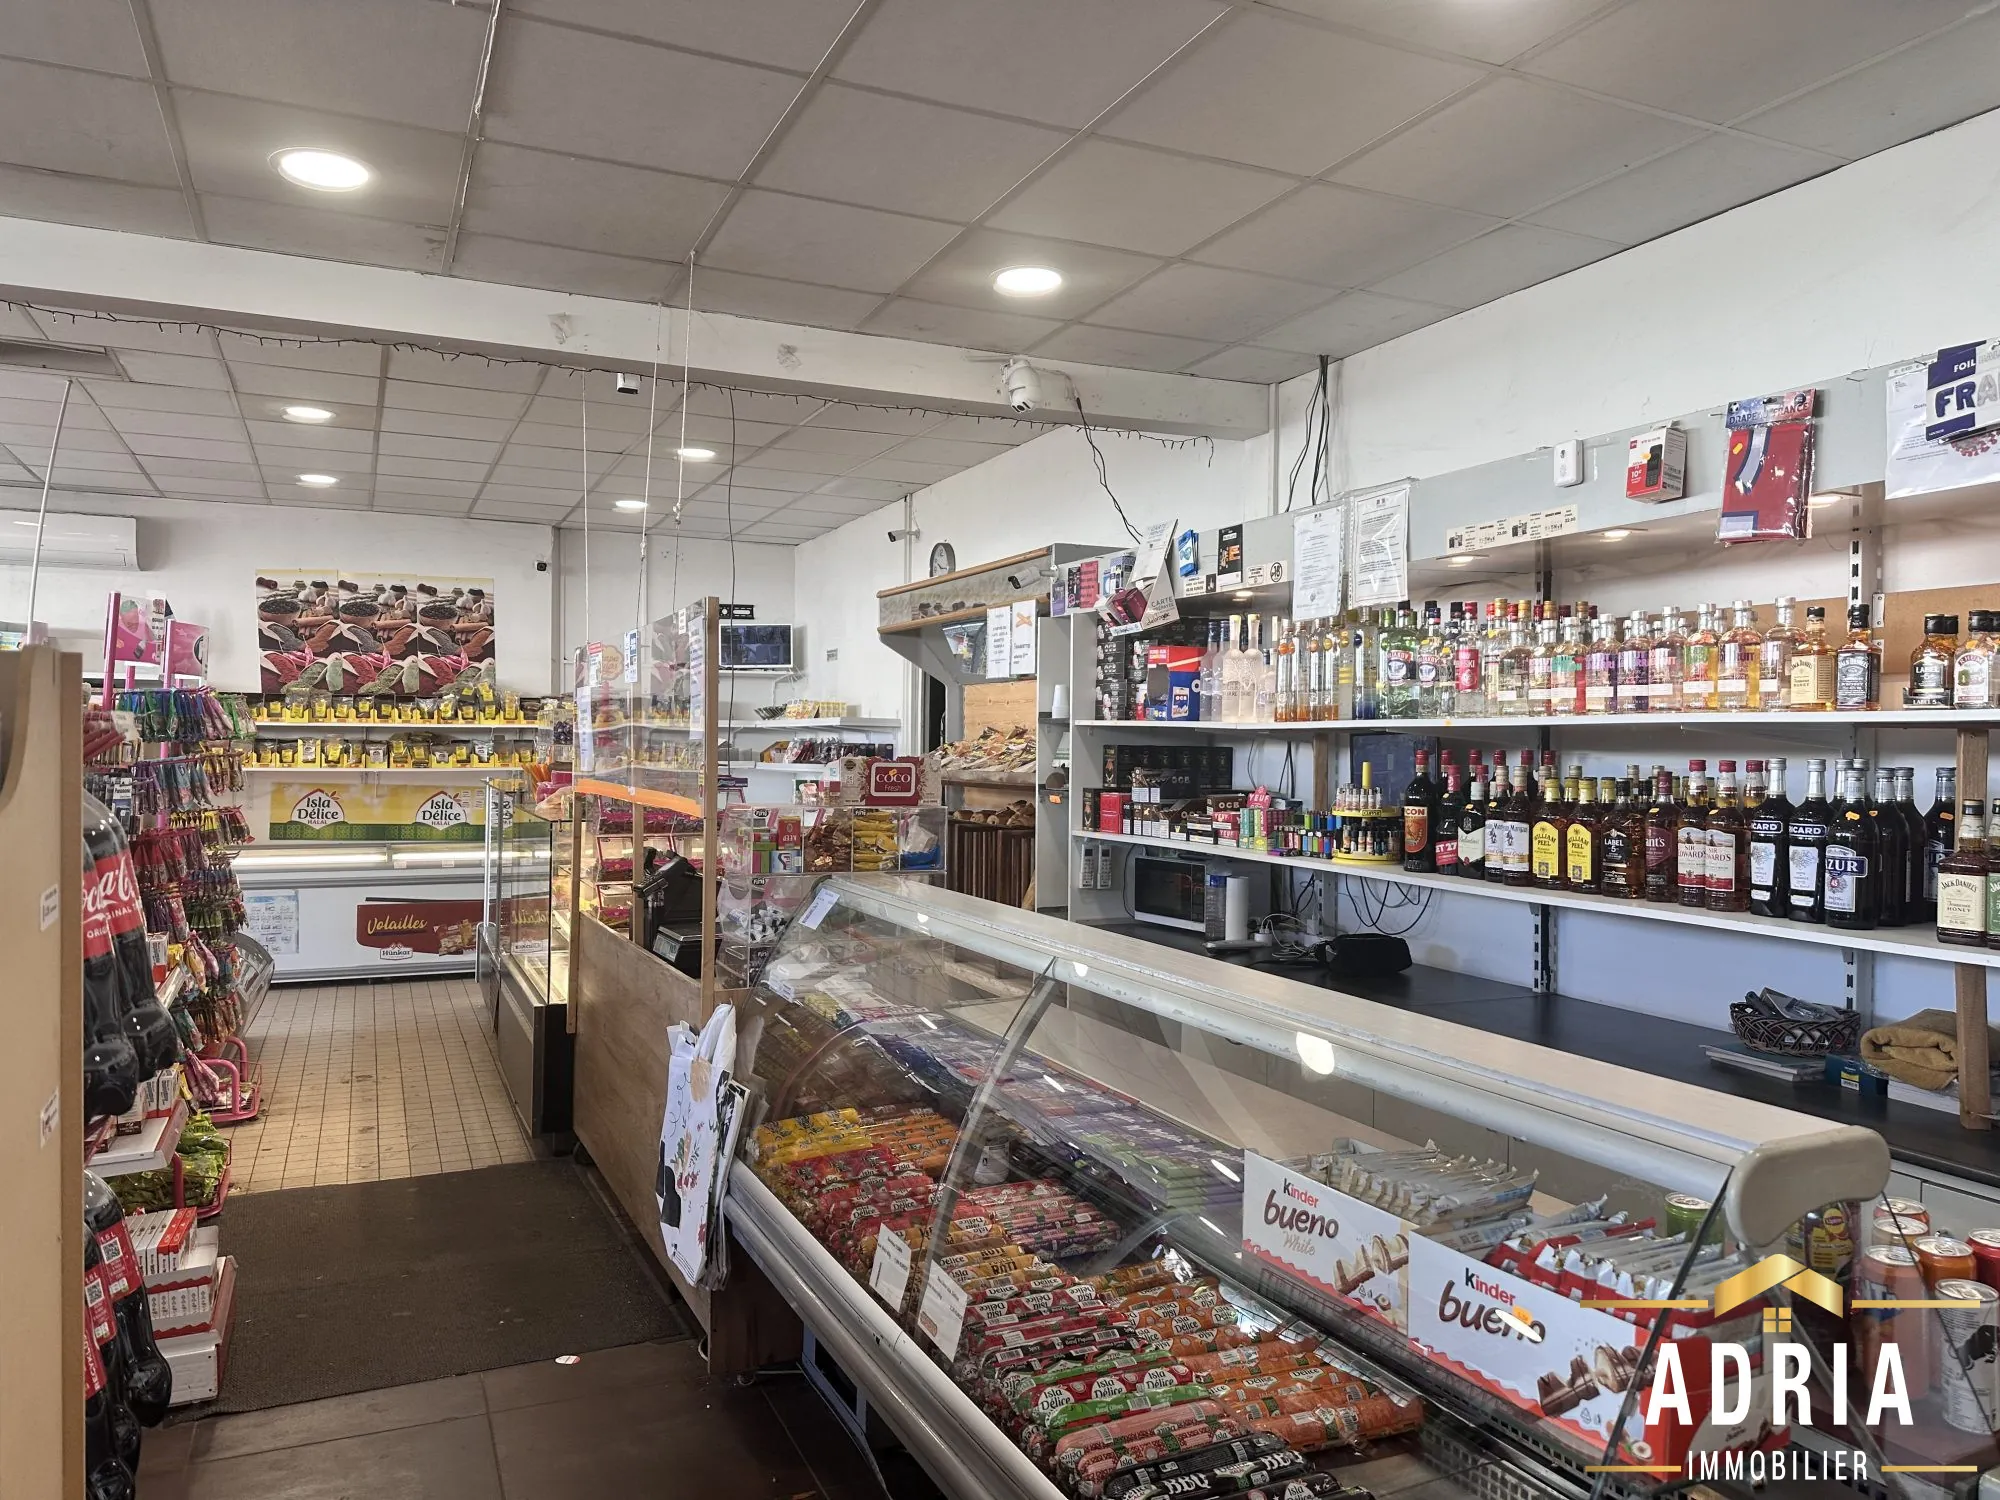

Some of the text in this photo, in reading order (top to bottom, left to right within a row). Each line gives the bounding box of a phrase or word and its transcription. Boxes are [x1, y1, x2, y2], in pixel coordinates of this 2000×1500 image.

[1953, 359, 1976, 373] FOIL
[1773, 402, 1808, 417] FRANCE
[1151, 596, 1173, 608] CARTE
[1916, 666, 1939, 674] LABEL
[876, 773, 911, 783] COCO
[306, 797, 331, 809] Isla
[430, 799, 454, 810] Isla
[1218, 801, 1240, 809] OCB
[297, 808, 338, 820] Délice
[422, 809, 461, 821] Délice
[1405, 808, 1425, 816] CON
[1436, 841, 1457, 853] ET 27
[1604, 838, 1624, 847] LABEL
[1645, 837, 1665, 847] ant's
[1826, 858, 1858, 872] ZUR
[1940, 879, 1955, 891] JACK
[367, 913, 428, 935] Volailles
[1264, 1189, 1339, 1239] bueno
[1283, 1231, 1315, 1256] White
[1174, 1316, 1189, 1324] Isla
[1174, 1322, 1200, 1333] Délice
[1148, 1371, 1165, 1380] Isla
[1097, 1379, 1115, 1388] Isla
[1146, 1378, 1174, 1390] Délice
[1044, 1389, 1062, 1399] Isla
[1094, 1386, 1123, 1399] Délice
[1041, 1396, 1071, 1411] Délice
[1119, 1457, 1133, 1466] Isla
[1259, 1449, 1305, 1472] BBQ
[1163, 1471, 1212, 1496] BBQ
[1287, 1485, 1304, 1497] Isla
